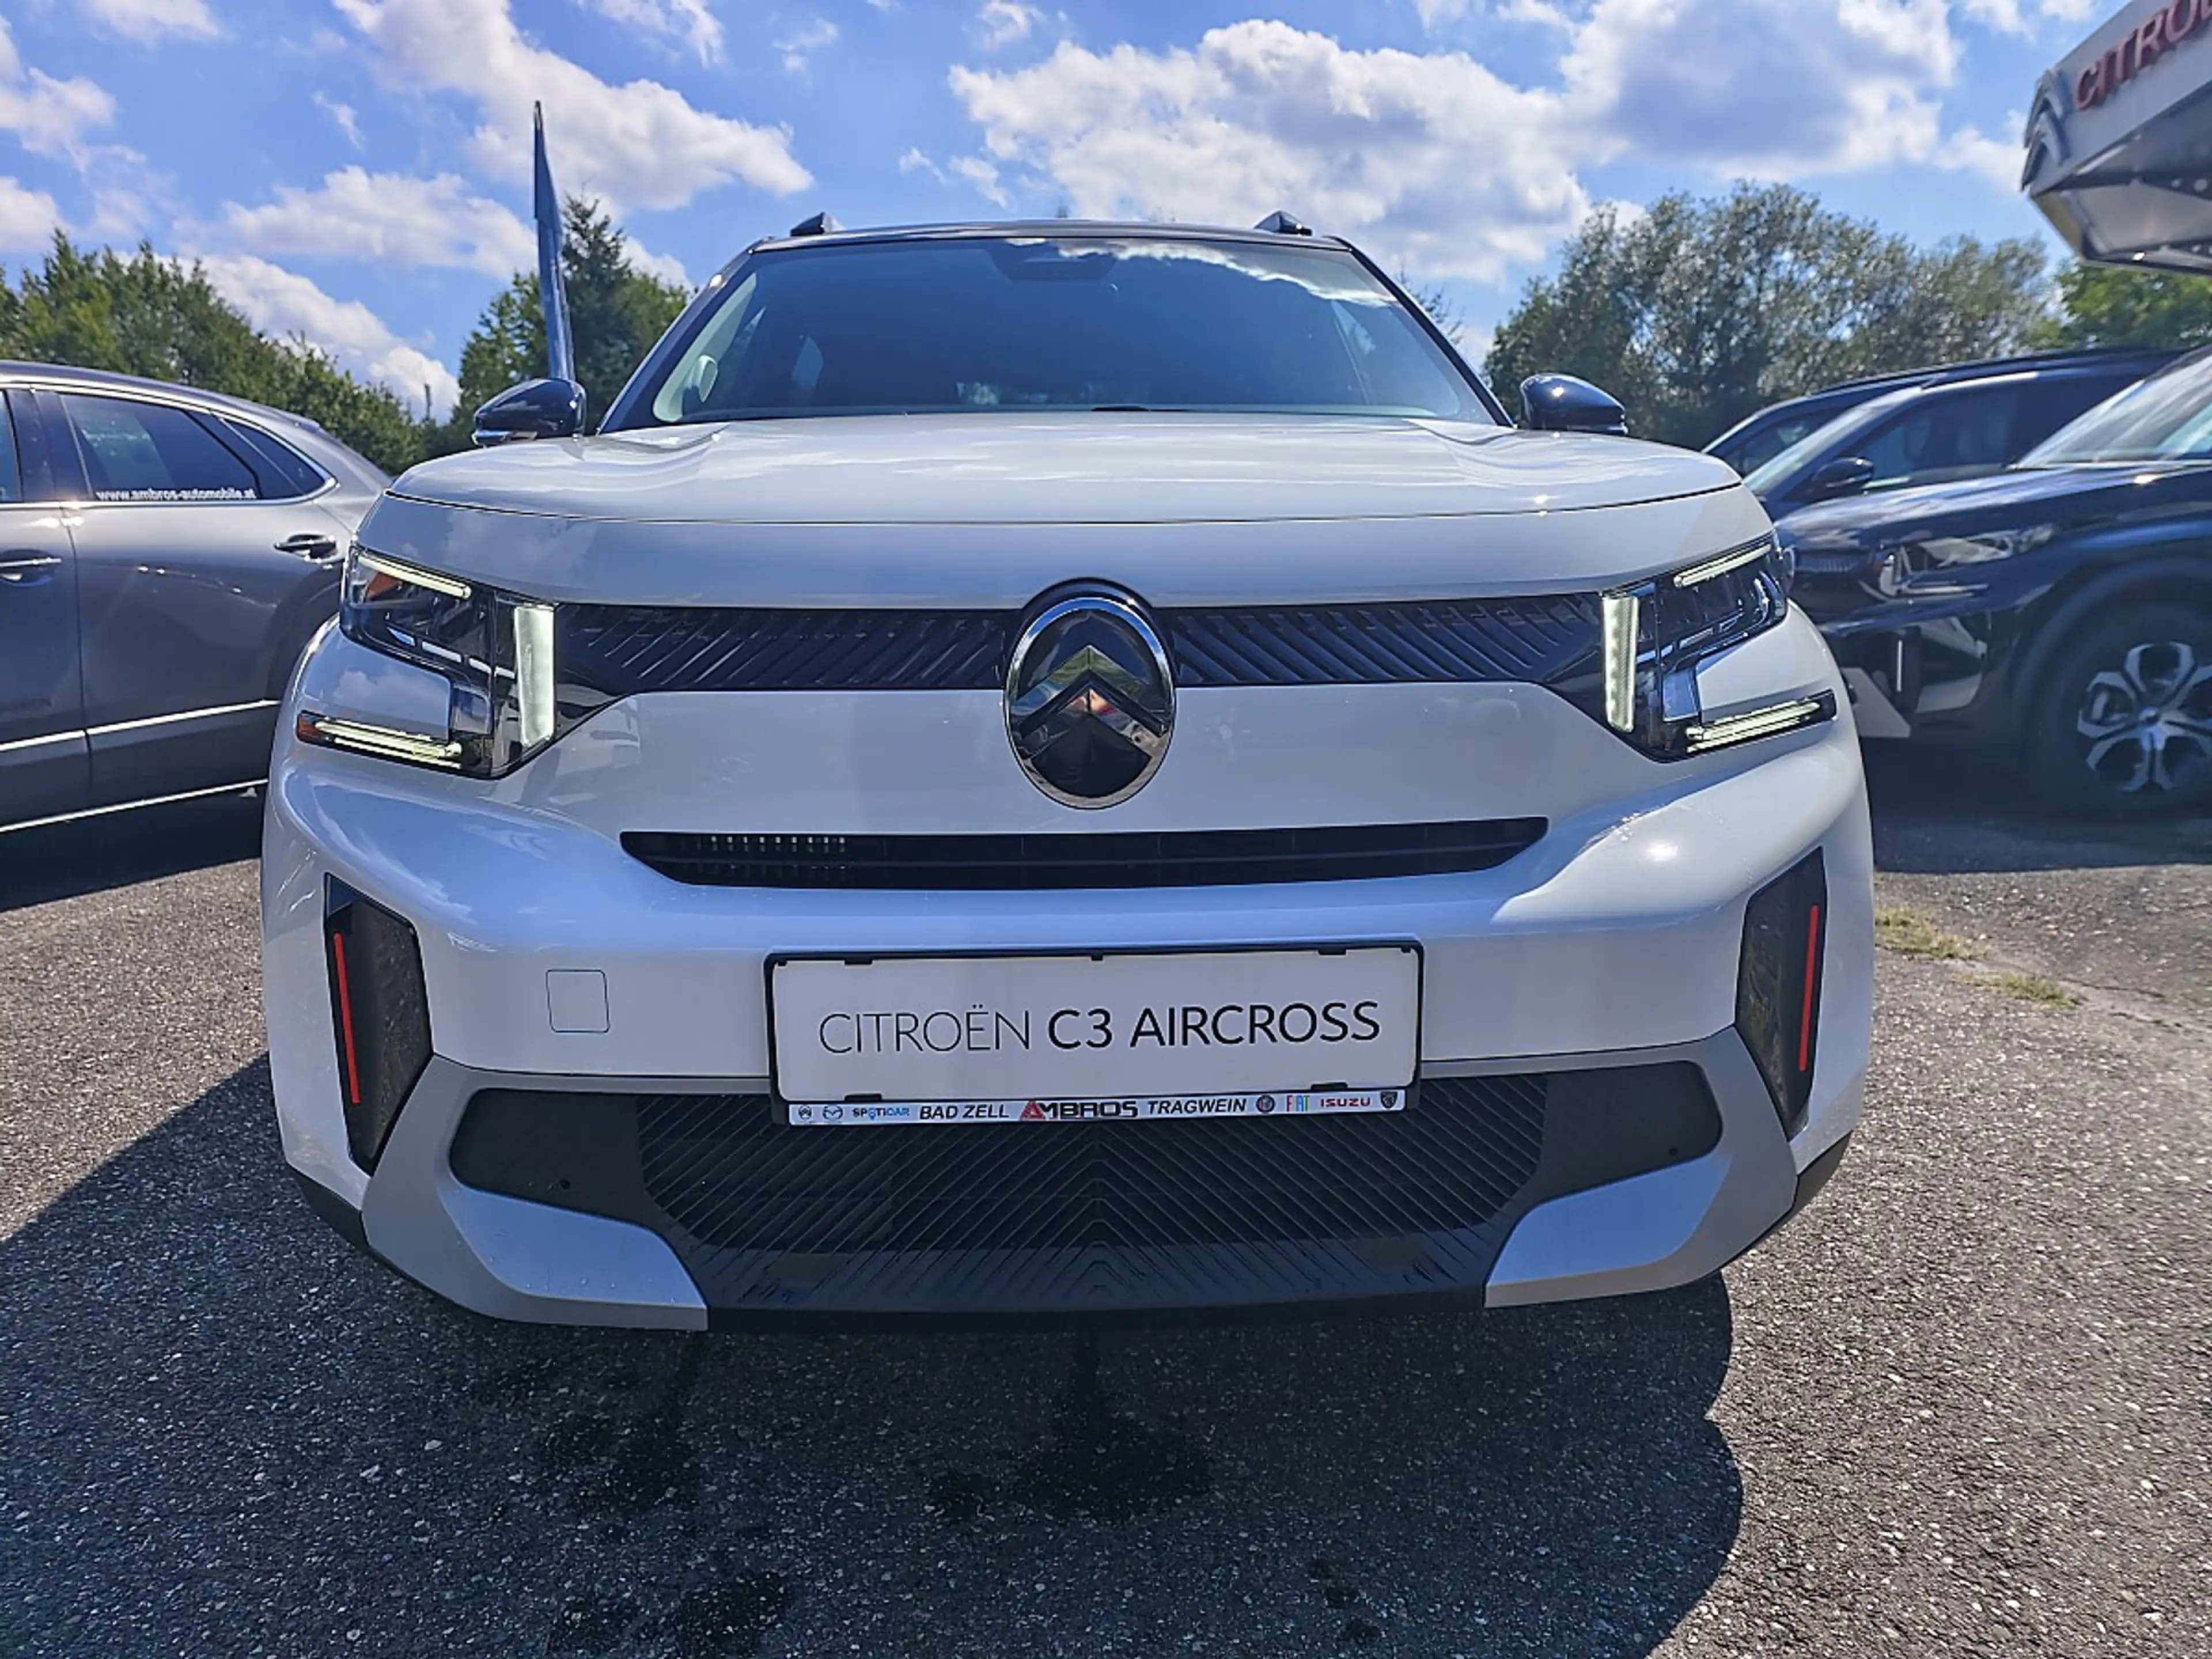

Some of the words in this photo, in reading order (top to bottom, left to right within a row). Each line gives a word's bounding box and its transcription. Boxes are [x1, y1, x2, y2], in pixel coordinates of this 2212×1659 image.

[820, 1004, 1029, 1054] CITROËN
[1048, 1008, 1113, 1049] C3
[1130, 1001, 1380, 1047] AIRCROSS
[919, 1105, 958, 1120] BAD
[962, 1104, 1009, 1119] ZELL
[1020, 1100, 1138, 1121] AMBROS
[1148, 1098, 1247, 1114] TRAGWEIN
[1286, 1094, 1310, 1112] FAT
[1320, 1097, 1370, 1107] ISUZU
